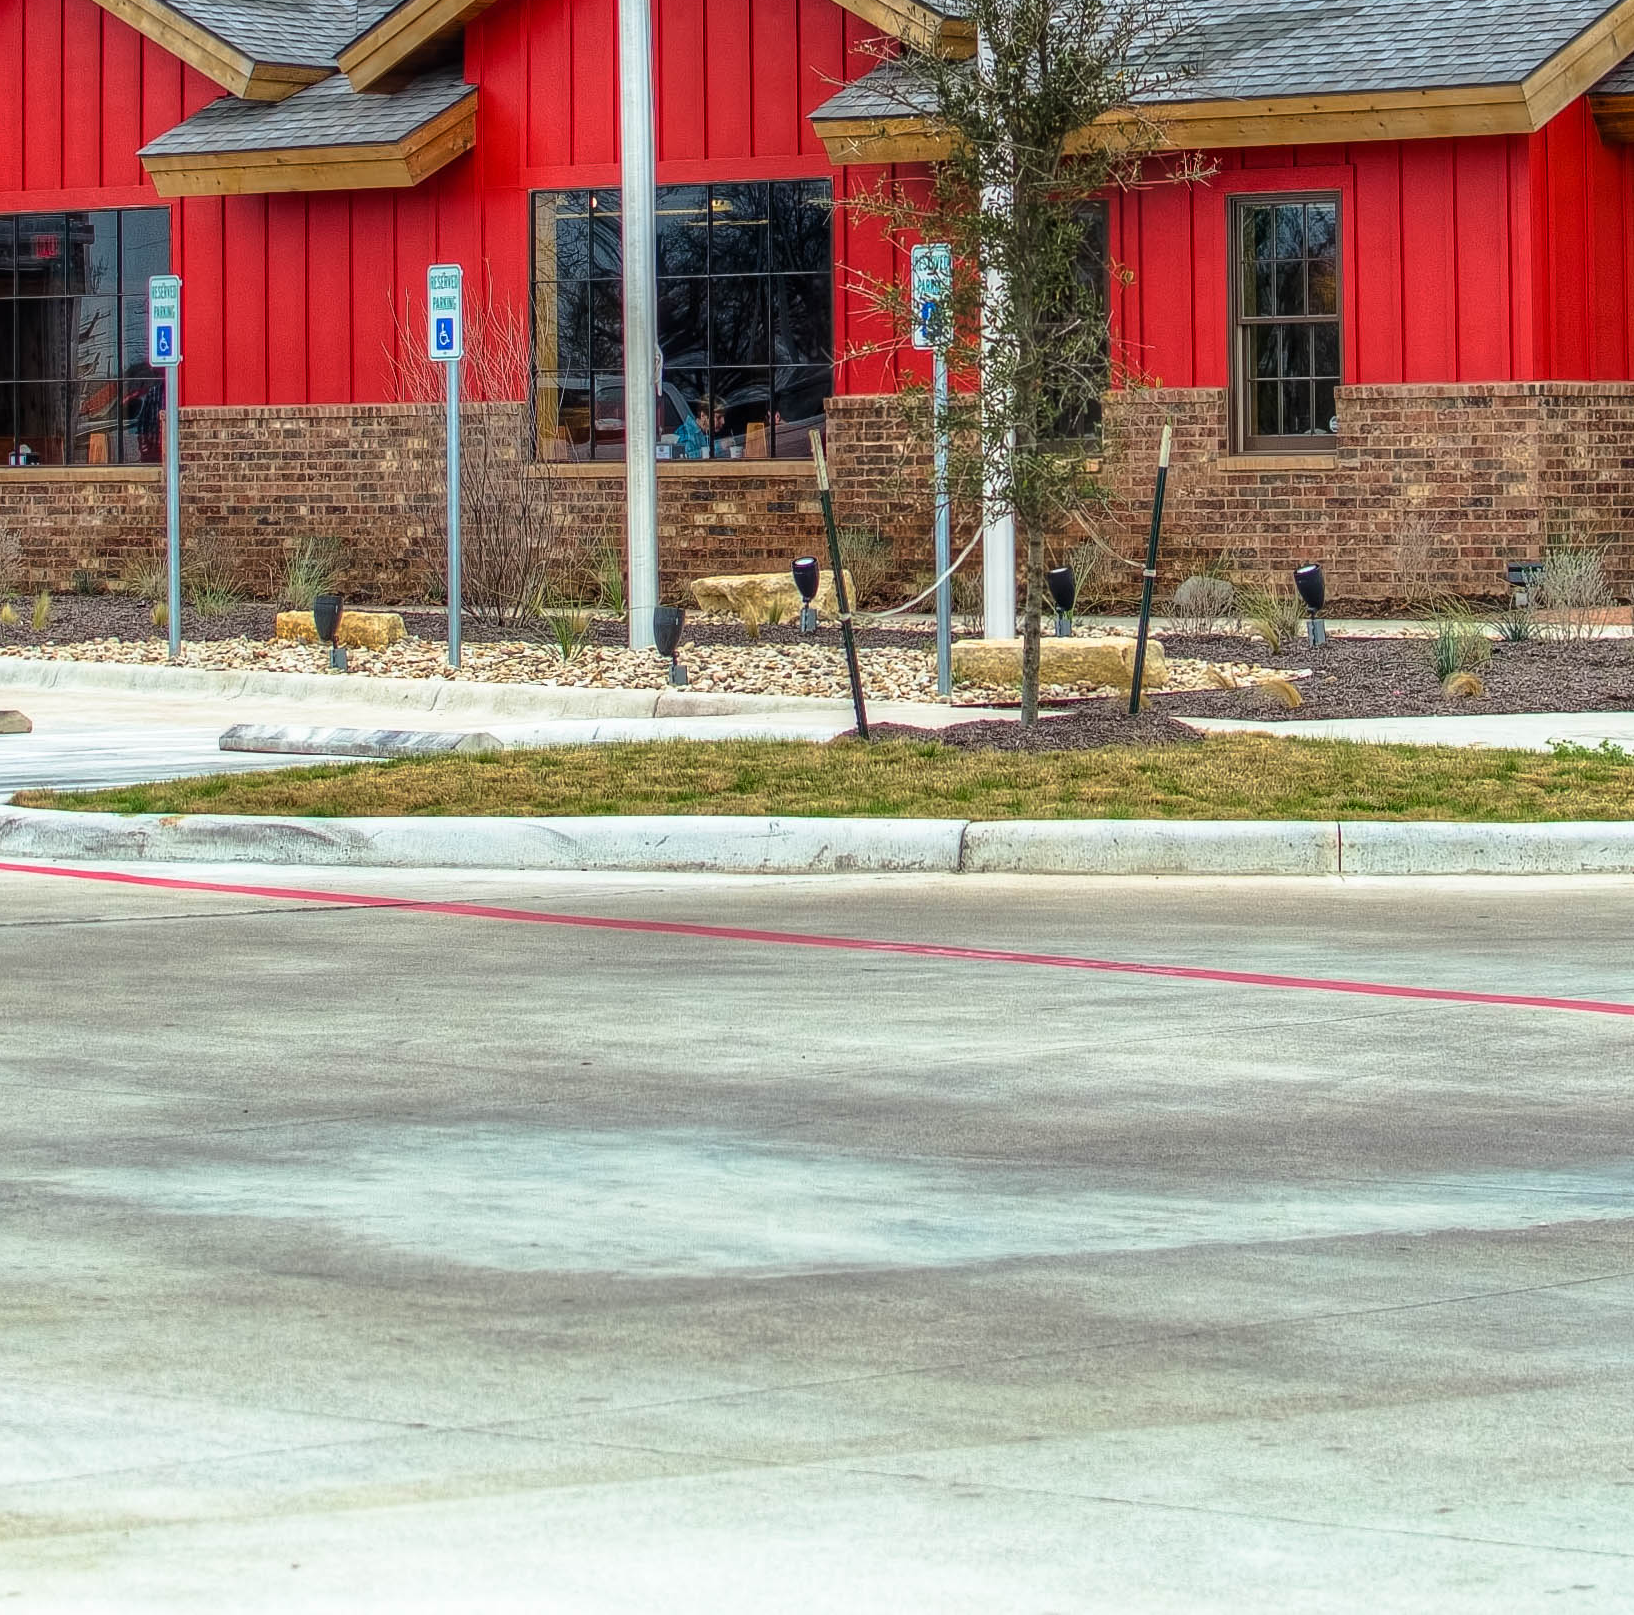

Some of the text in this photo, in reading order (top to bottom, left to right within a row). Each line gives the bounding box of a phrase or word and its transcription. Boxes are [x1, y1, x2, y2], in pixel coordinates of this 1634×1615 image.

[430, 274, 458, 290] RESERVED
[152, 286, 176, 299] RESERVED
[433, 296, 456, 310] PARKING
[154, 305, 175, 318] PARKING
